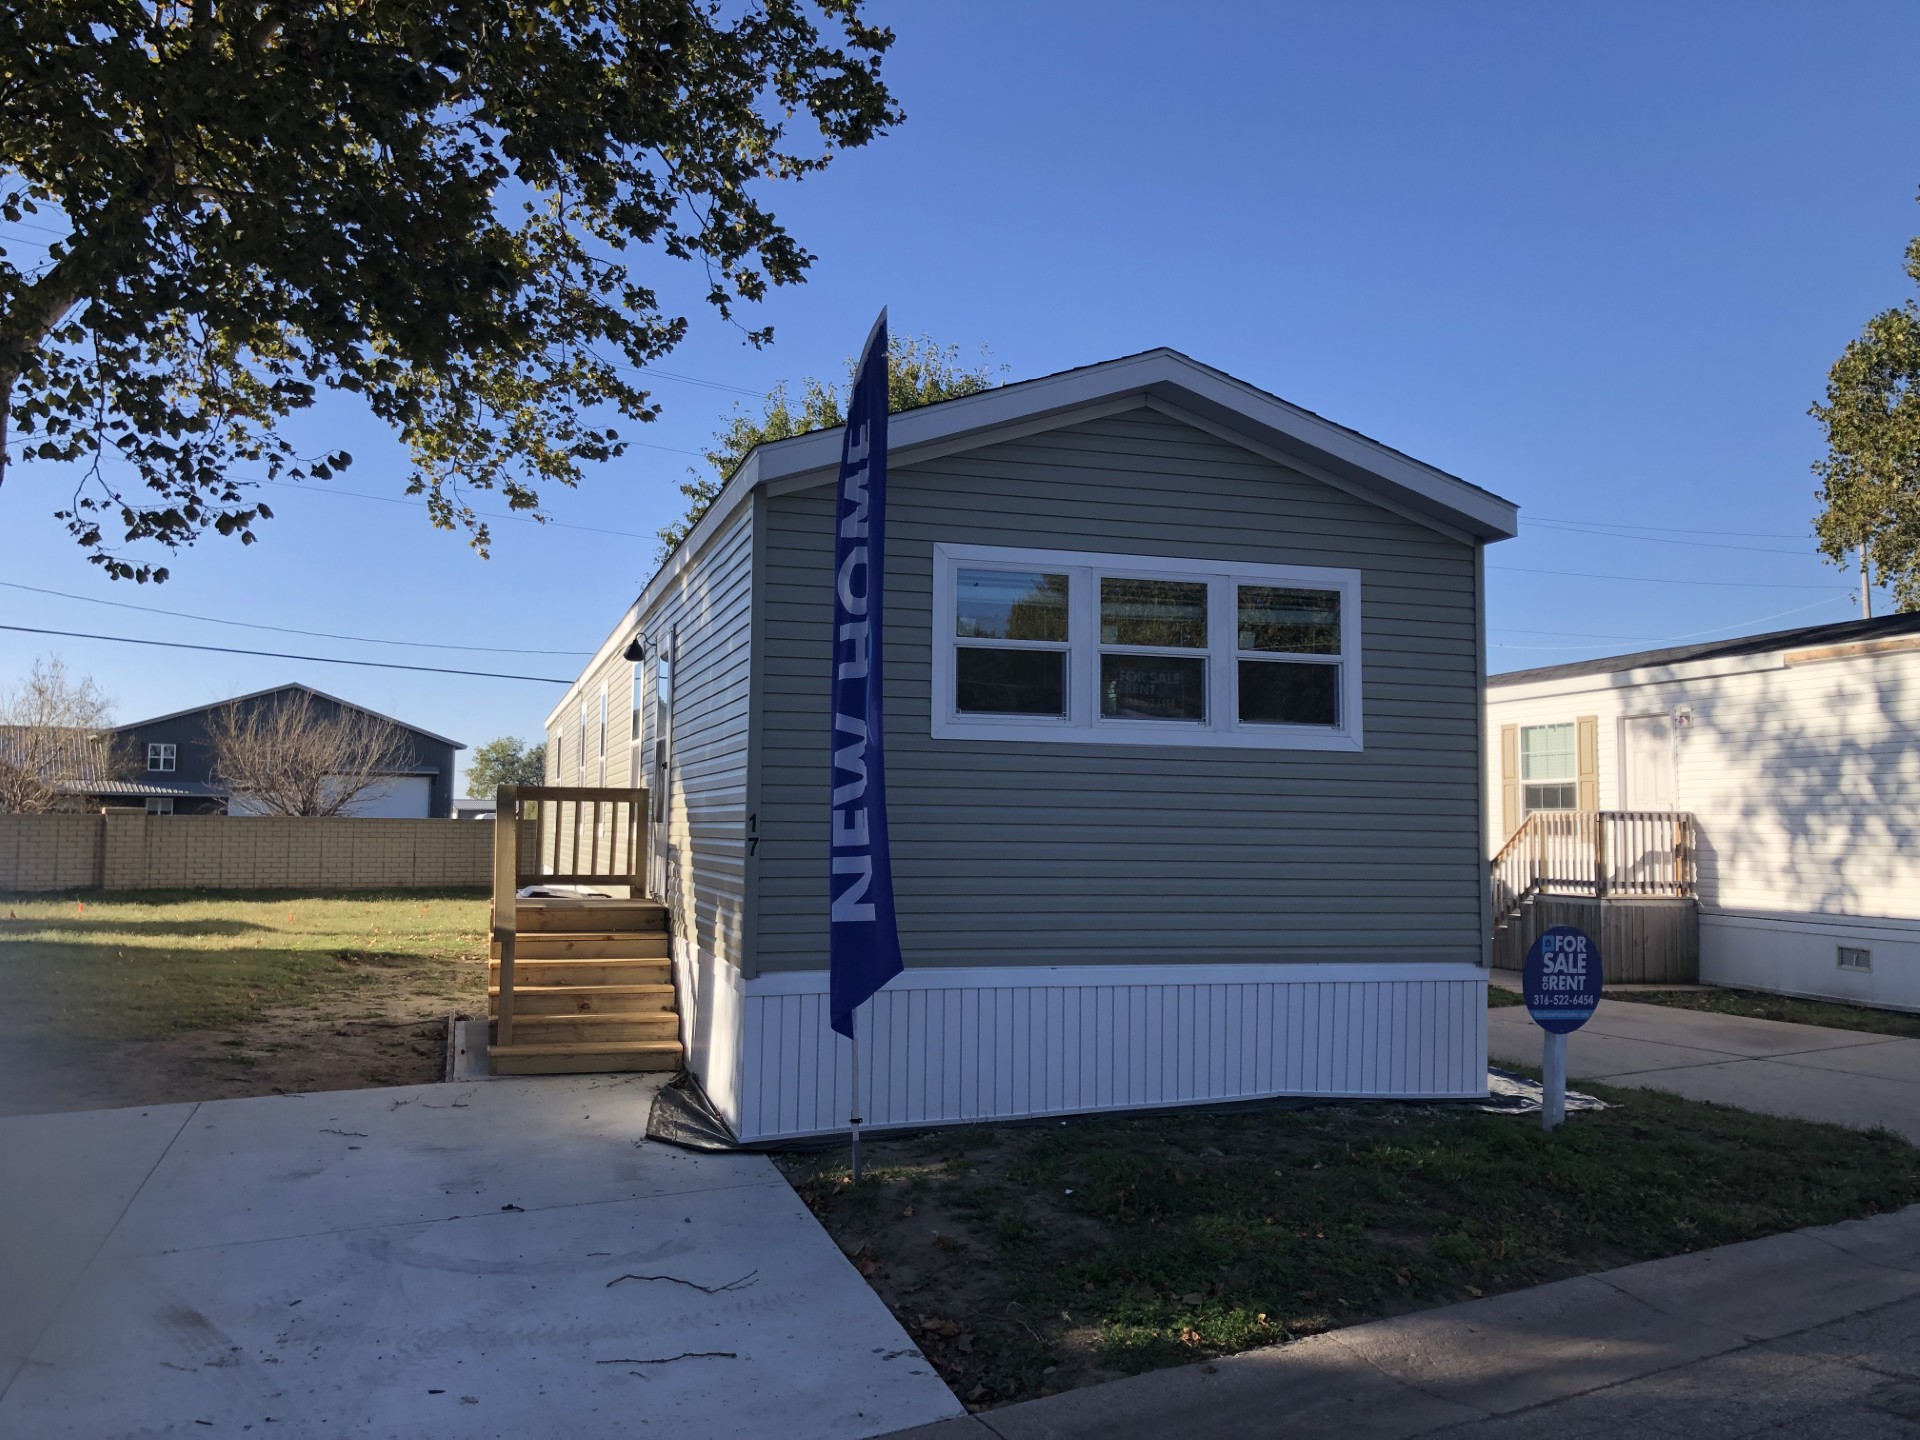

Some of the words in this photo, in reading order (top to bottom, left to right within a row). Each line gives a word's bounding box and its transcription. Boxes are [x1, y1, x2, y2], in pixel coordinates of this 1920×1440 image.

[838, 418, 870, 681] HOME
[1120, 670, 1147, 683] FOR
[1150, 671, 1180, 684] SALE
[1125, 684, 1156, 695] RENT
[831, 712, 876, 923] NEW
[1555, 935, 1587, 953] FOR
[1542, 952, 1587, 974] SALE
[1542, 975, 1549, 991] OR
[1549, 975, 1587, 991] RENT
[1533, 994, 1594, 1006] 316-522-6454
